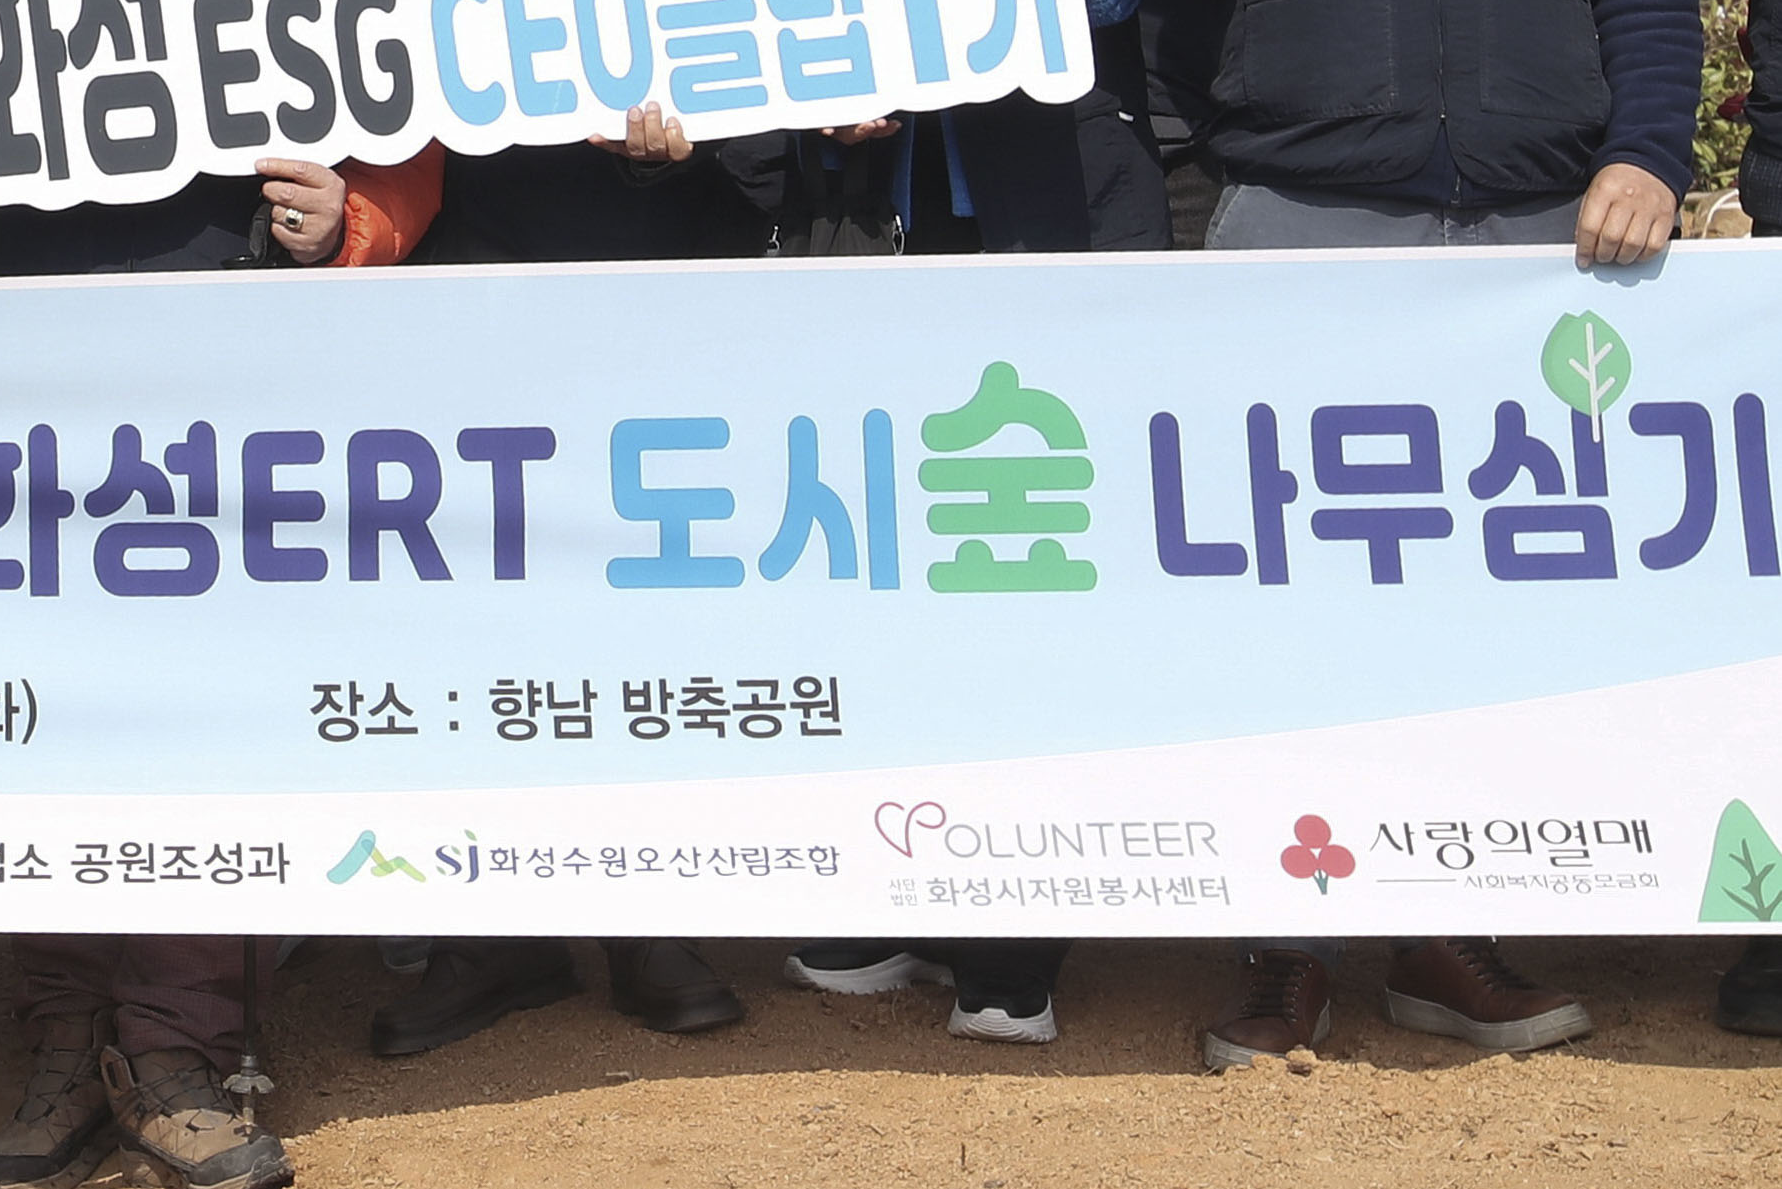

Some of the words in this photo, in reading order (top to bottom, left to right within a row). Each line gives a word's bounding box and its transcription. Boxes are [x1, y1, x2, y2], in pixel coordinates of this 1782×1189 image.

[1148, 392, 1782, 587] 나무심기
[309, 680, 419, 743] 장소
[488, 678, 598, 741] 향남
[621, 675, 843, 740] 방축공원
[70, 841, 291, 886] 공원조성과
[488, 844, 843, 879] 화성수원오산산림조합
[1370, 818, 1654, 871] 사랑의열매
[889, 877, 916, 892] 사단
[926, 875, 1232, 908] 화성시자원봉사센터
[1464, 872, 1660, 895] 사회복지공동모금회
